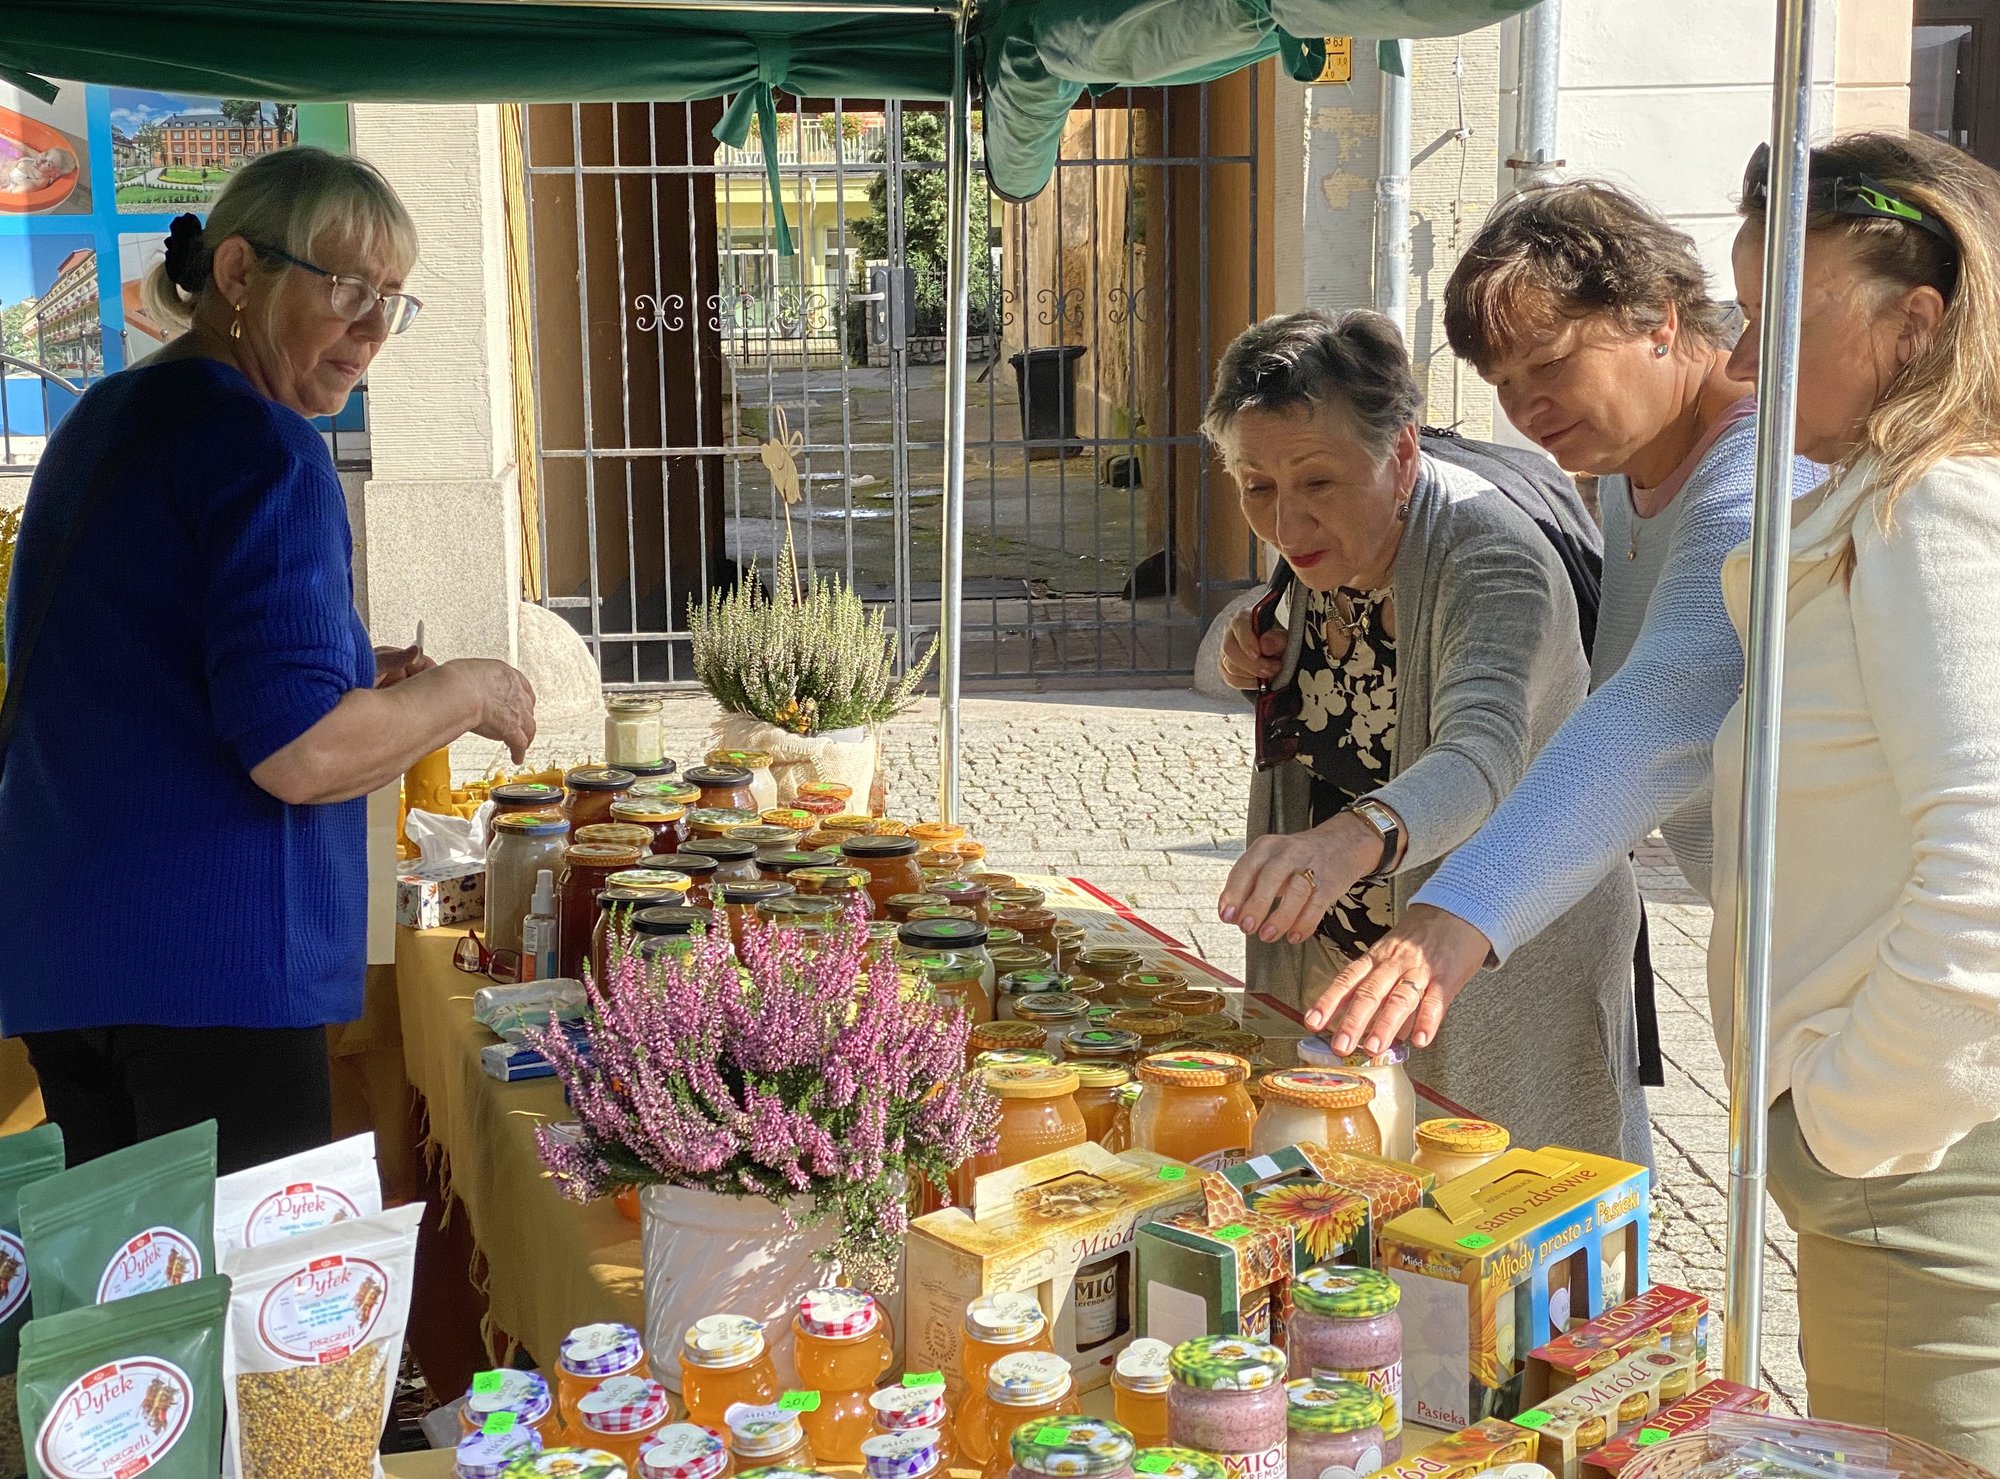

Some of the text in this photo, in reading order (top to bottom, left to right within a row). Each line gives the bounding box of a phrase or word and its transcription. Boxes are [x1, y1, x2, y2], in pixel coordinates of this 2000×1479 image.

[1475, 1206, 1528, 1233] samo
[1524, 1169, 1598, 1208] zdrowie
[1070, 1215, 1143, 1264] Miód
[1490, 1184, 1641, 1288] Miody prosto z Pasieki
[1075, 1270, 1115, 1301] MIÓ
[1590, 1289, 1675, 1331] HONEY
[1012, 1360, 1048, 1374] MIÓD
[1571, 1360, 1652, 1412] Miód
[891, 1387, 928, 1401] MIÓD
[1416, 1400, 1467, 1427] Pasieka
[1647, 1384, 1734, 1432] HONEY
